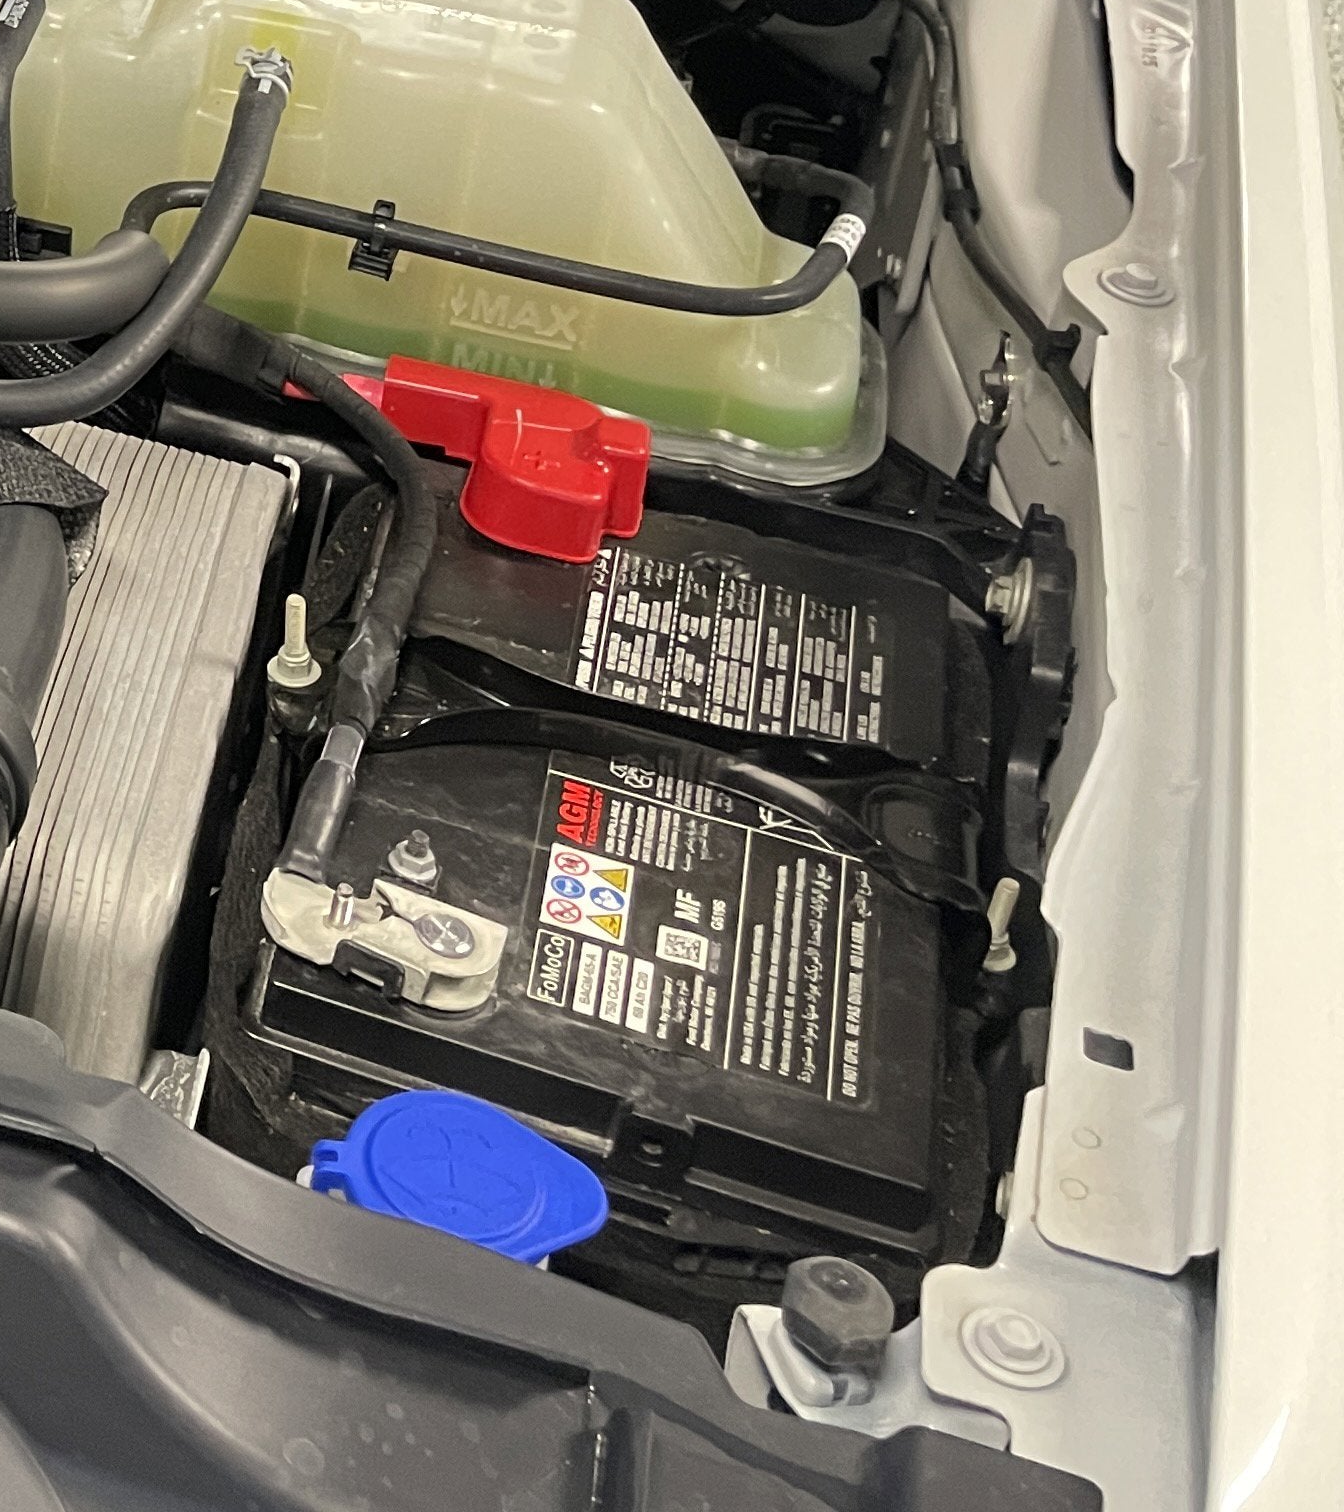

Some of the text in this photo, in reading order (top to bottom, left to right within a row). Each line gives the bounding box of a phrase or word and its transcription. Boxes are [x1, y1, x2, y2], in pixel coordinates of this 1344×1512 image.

[470, 288, 579, 342] MAX
[452, 344, 537, 383] MIN
[552, 778, 594, 843] AGM
[673, 888, 702, 923] MF
[536, 933, 565, 1001] FoMoCo
[841, 1081, 857, 1097] DO
